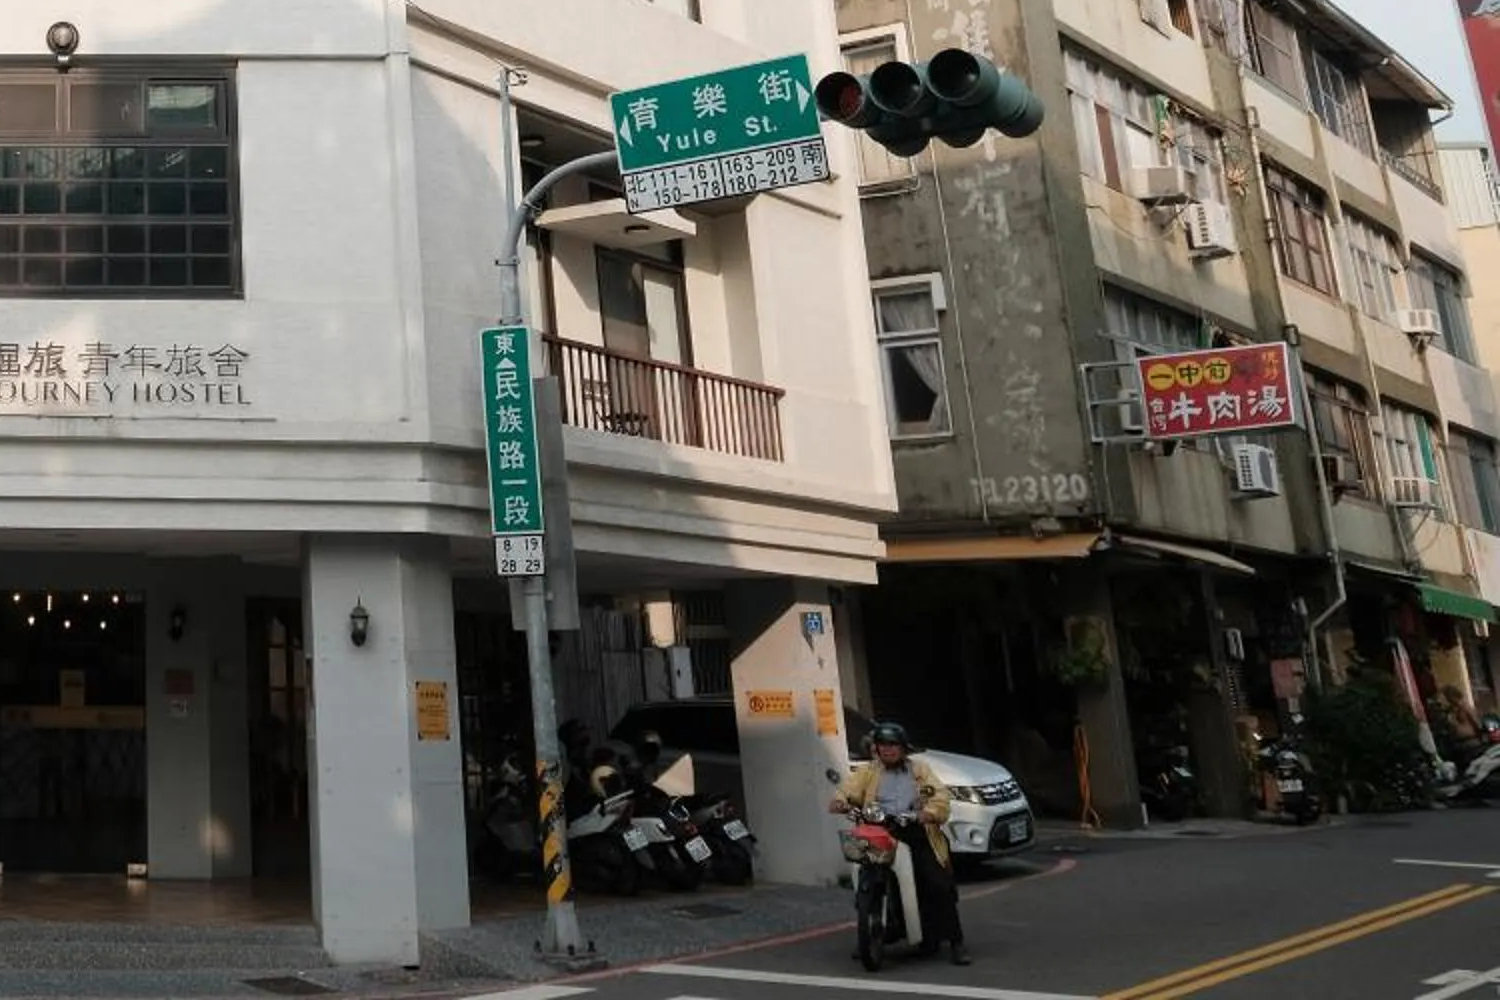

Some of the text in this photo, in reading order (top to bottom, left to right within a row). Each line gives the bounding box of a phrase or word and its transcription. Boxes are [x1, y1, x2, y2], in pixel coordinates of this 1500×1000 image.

[628, 69, 793, 133] 育樂街
[656, 114, 778, 153] Yule St.
[725, 143, 823, 175] 163-209 南
[627, 163, 719, 195] 北 111-161
[653, 181, 722, 207] 150-178
[728, 165, 799, 193] 180-212
[77, 341, 250, 378] 青年旅舍
[494, 333, 516, 355] 東
[133, 381, 252, 406] HOSTEL
[1168, 385, 1287, 430] 牛肉湯
[494, 371, 531, 526] 民族路一段
[503, 537, 539, 552] 8 19
[501, 559, 541, 573] 28 29
